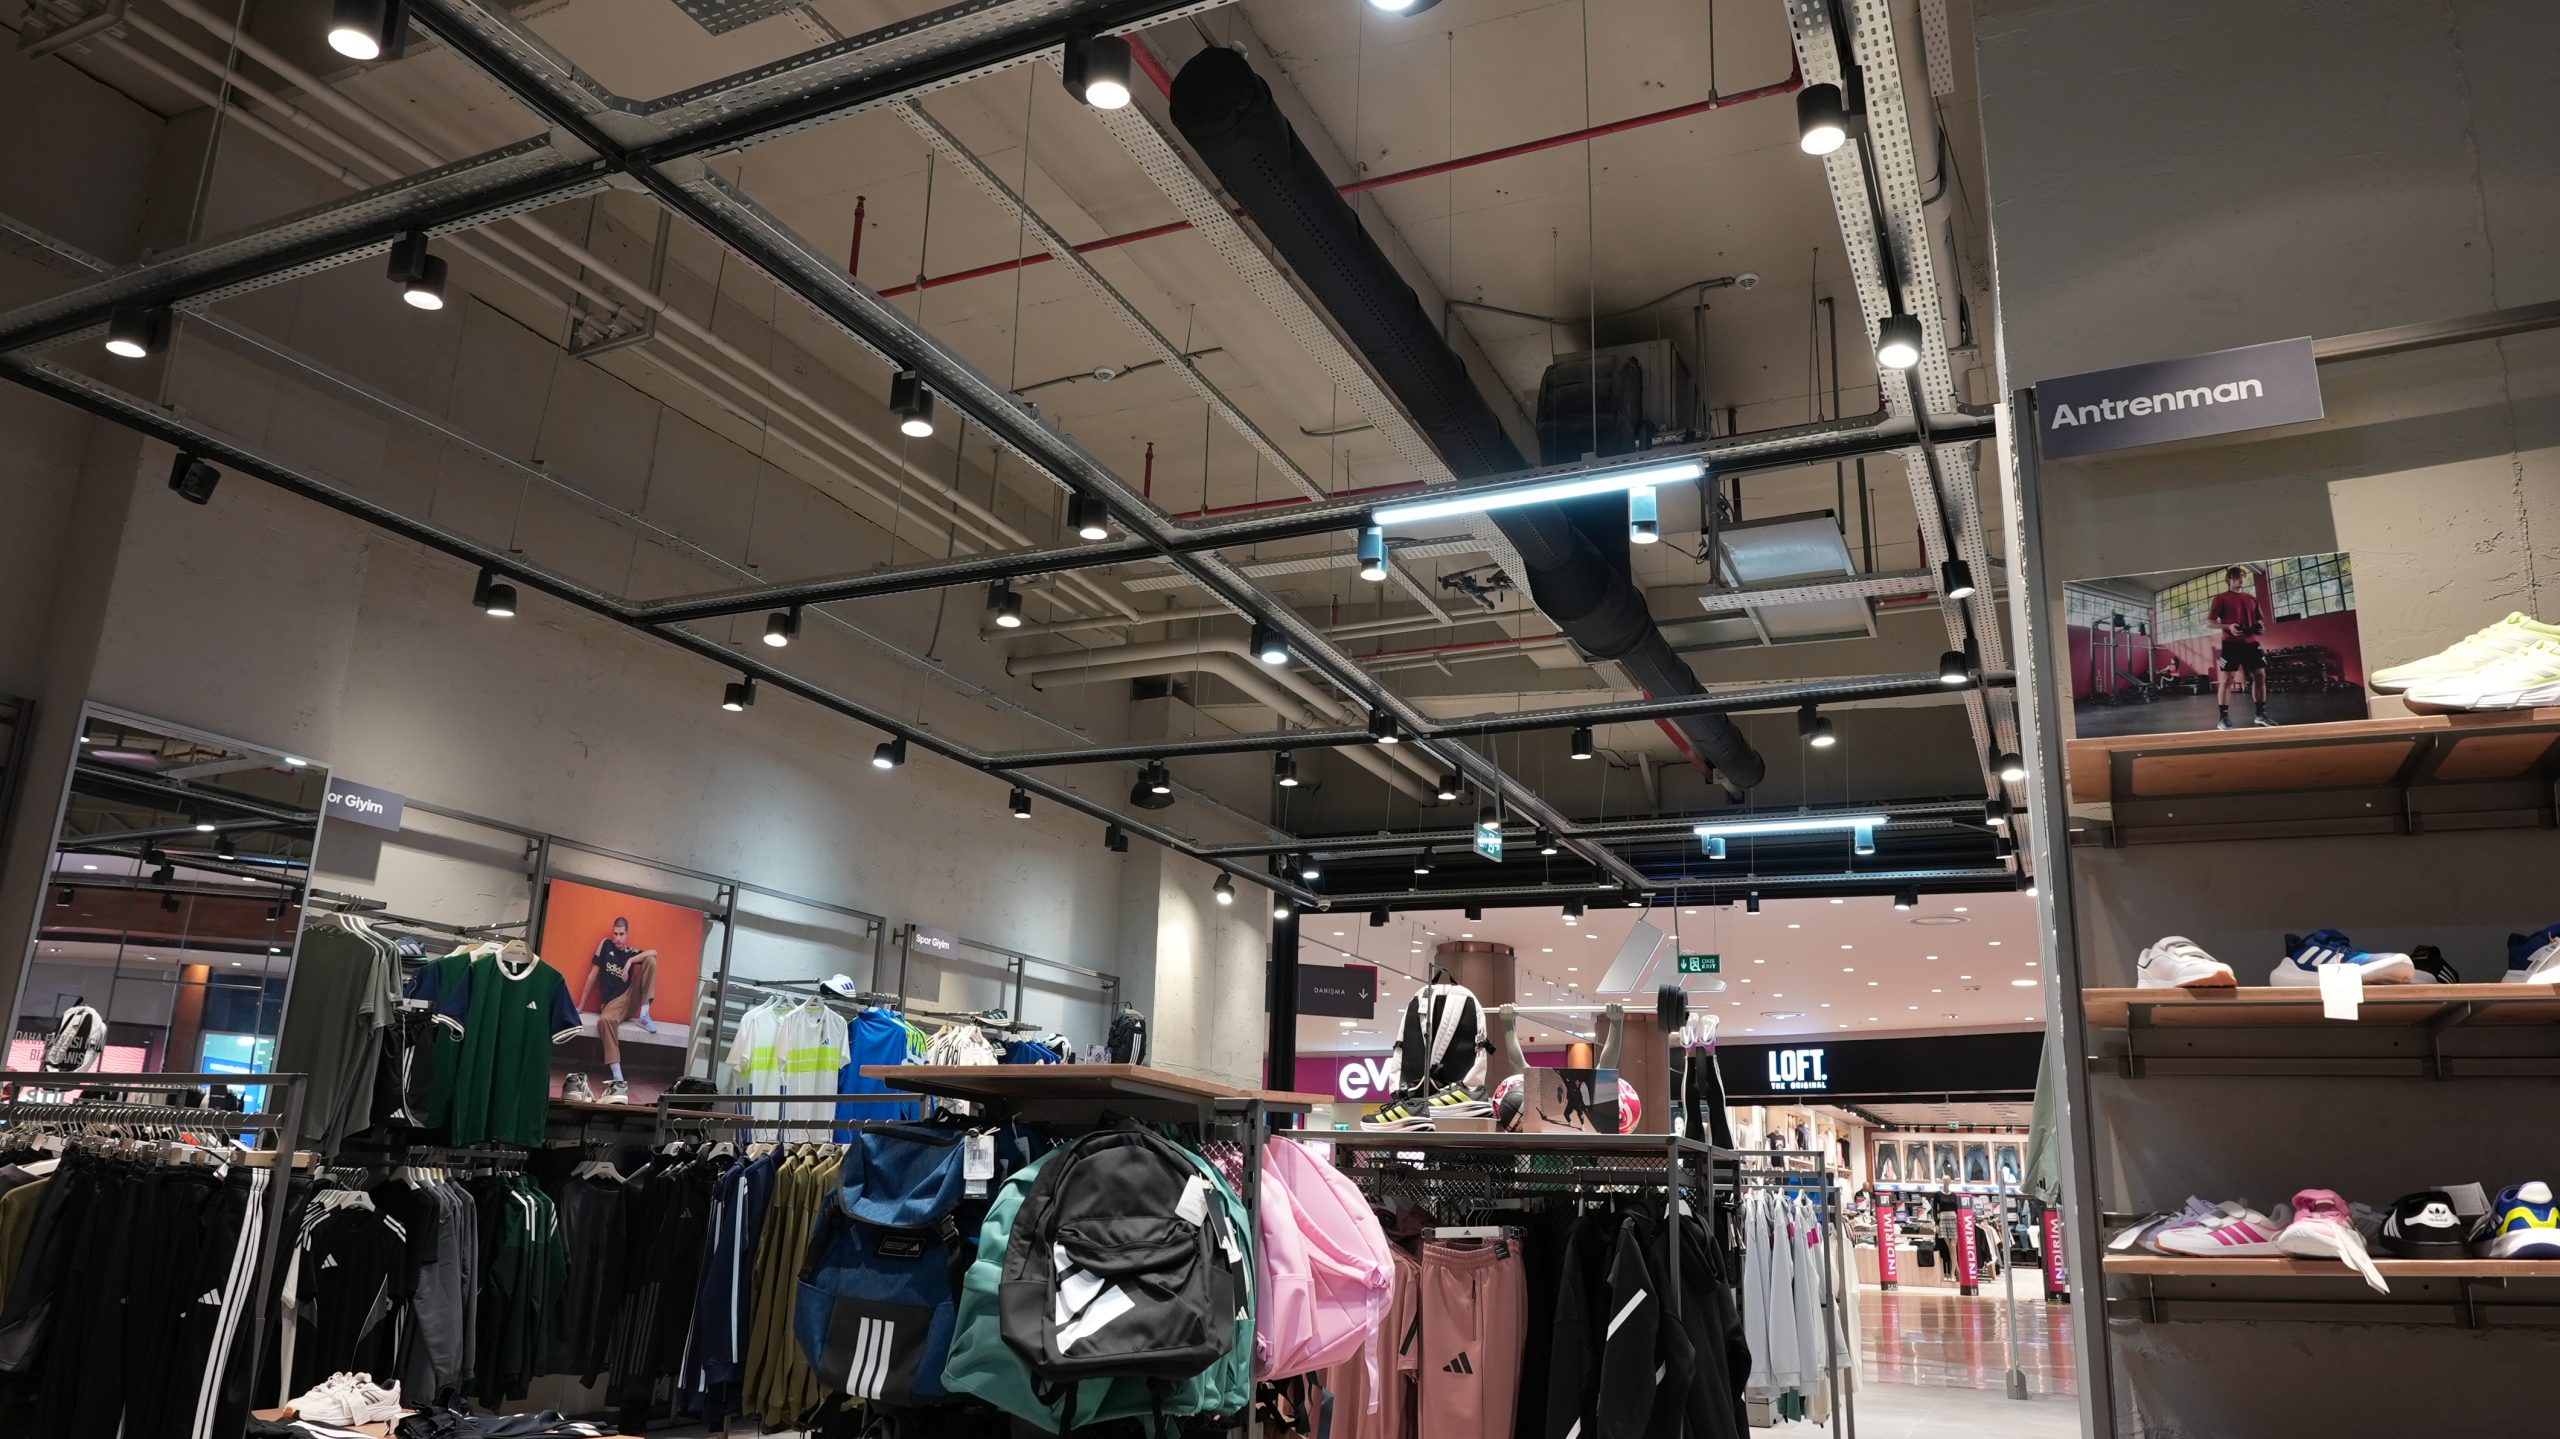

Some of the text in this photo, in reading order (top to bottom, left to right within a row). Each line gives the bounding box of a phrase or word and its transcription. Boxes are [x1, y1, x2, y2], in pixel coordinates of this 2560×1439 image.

[2051, 378, 2263, 430] Antrenman
[915, 933, 931, 945] Spor
[1771, 1081, 1827, 1090] THE ORIGINAL
